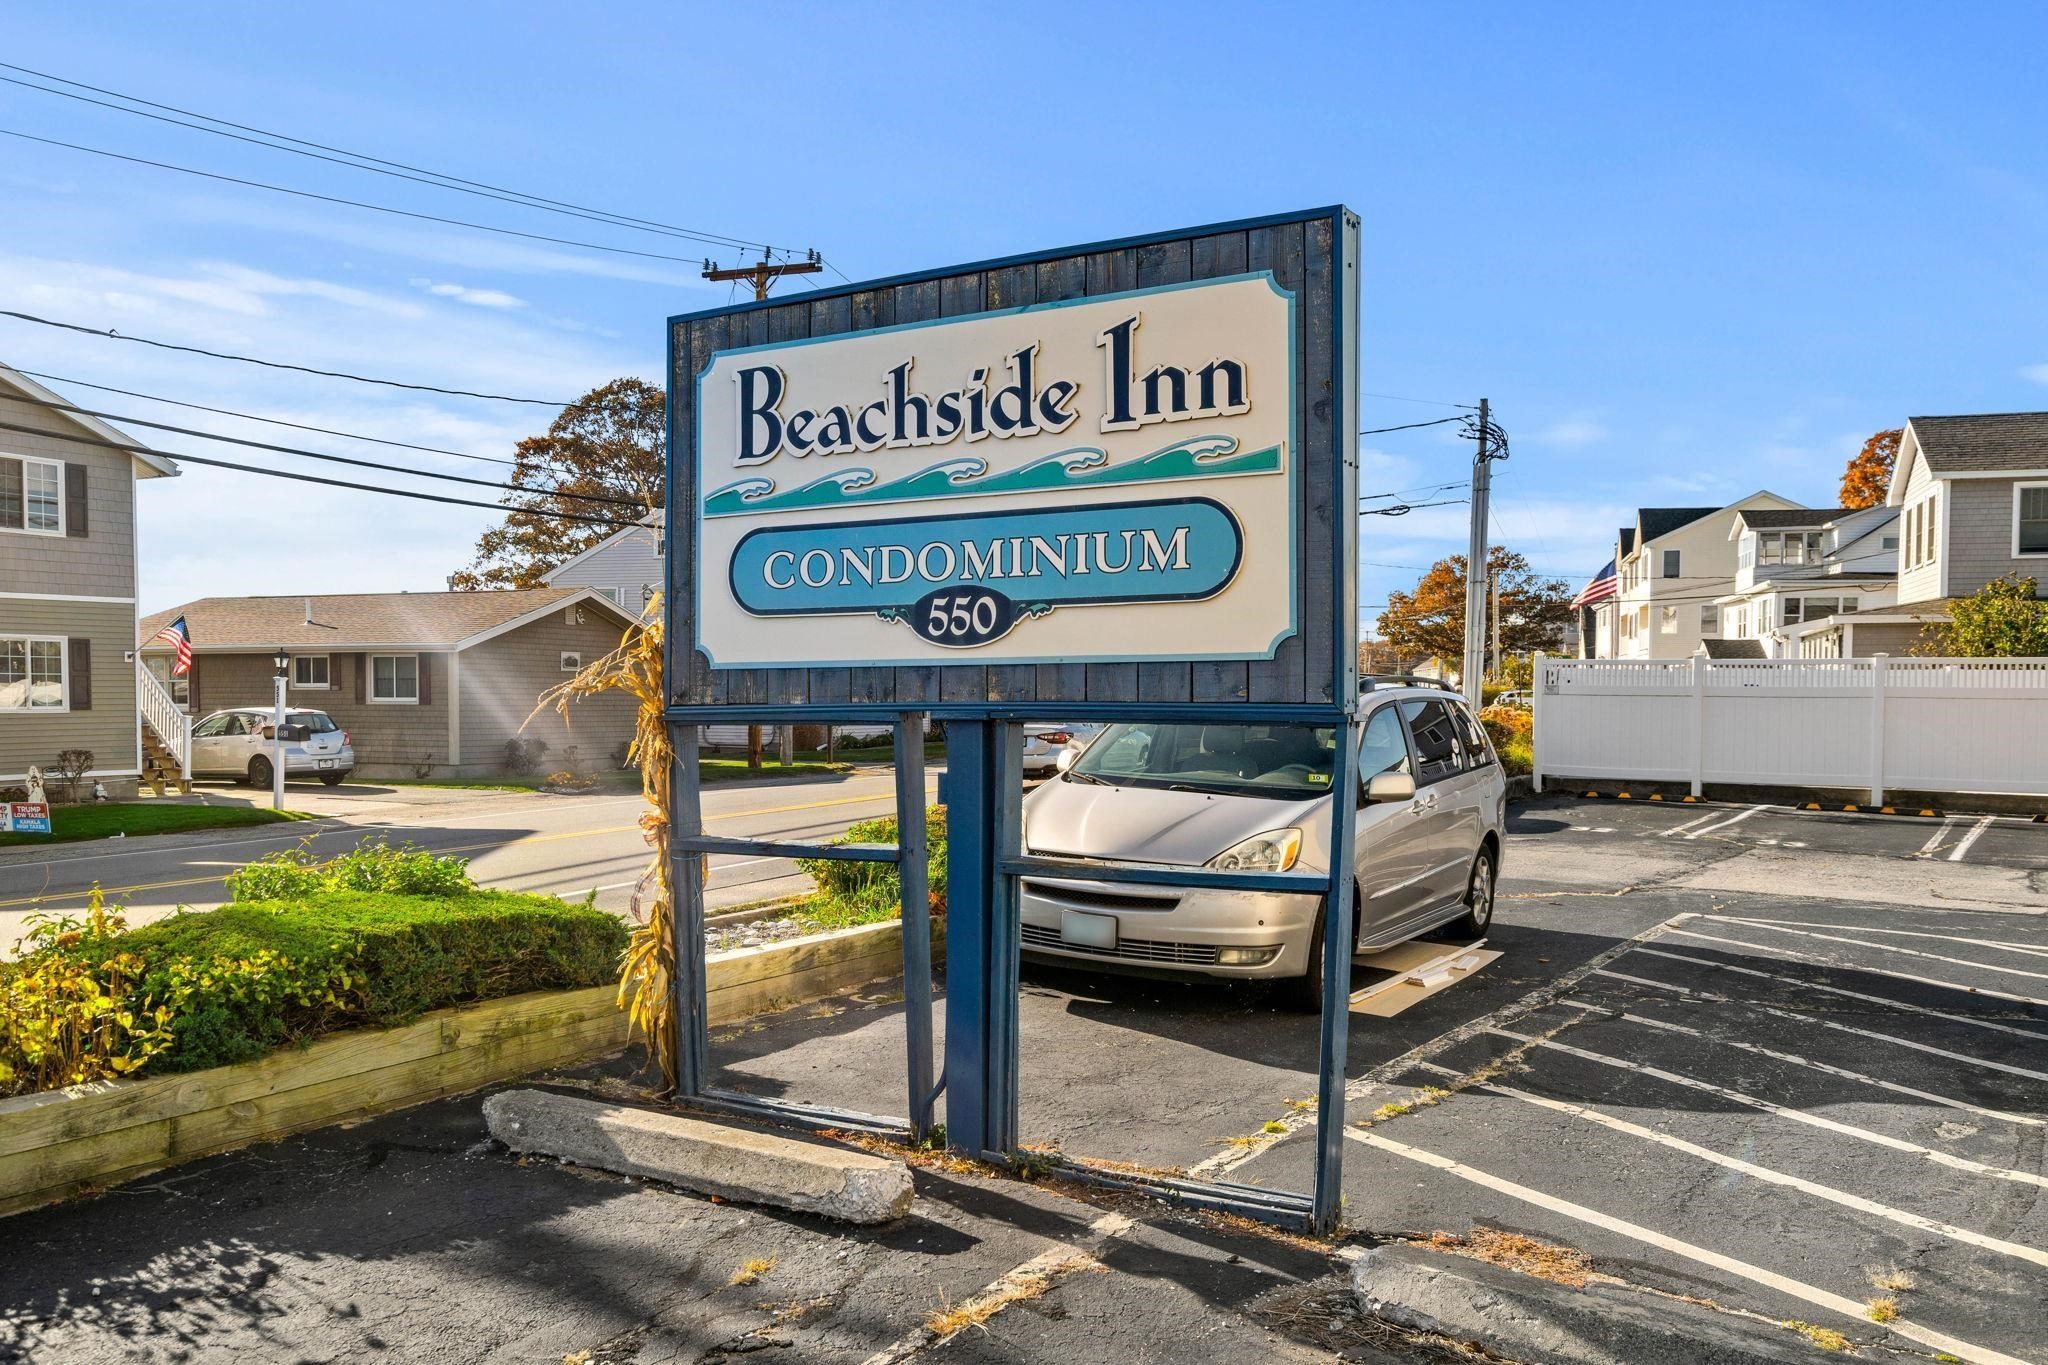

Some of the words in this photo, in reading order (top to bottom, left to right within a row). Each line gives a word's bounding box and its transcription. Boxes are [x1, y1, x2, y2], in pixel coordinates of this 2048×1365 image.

[735, 342, 1076, 461] Beachside
[1101, 314, 1248, 425] Inn
[762, 525, 1192, 590] CONDOMINIUM
[927, 595, 998, 637] 550
